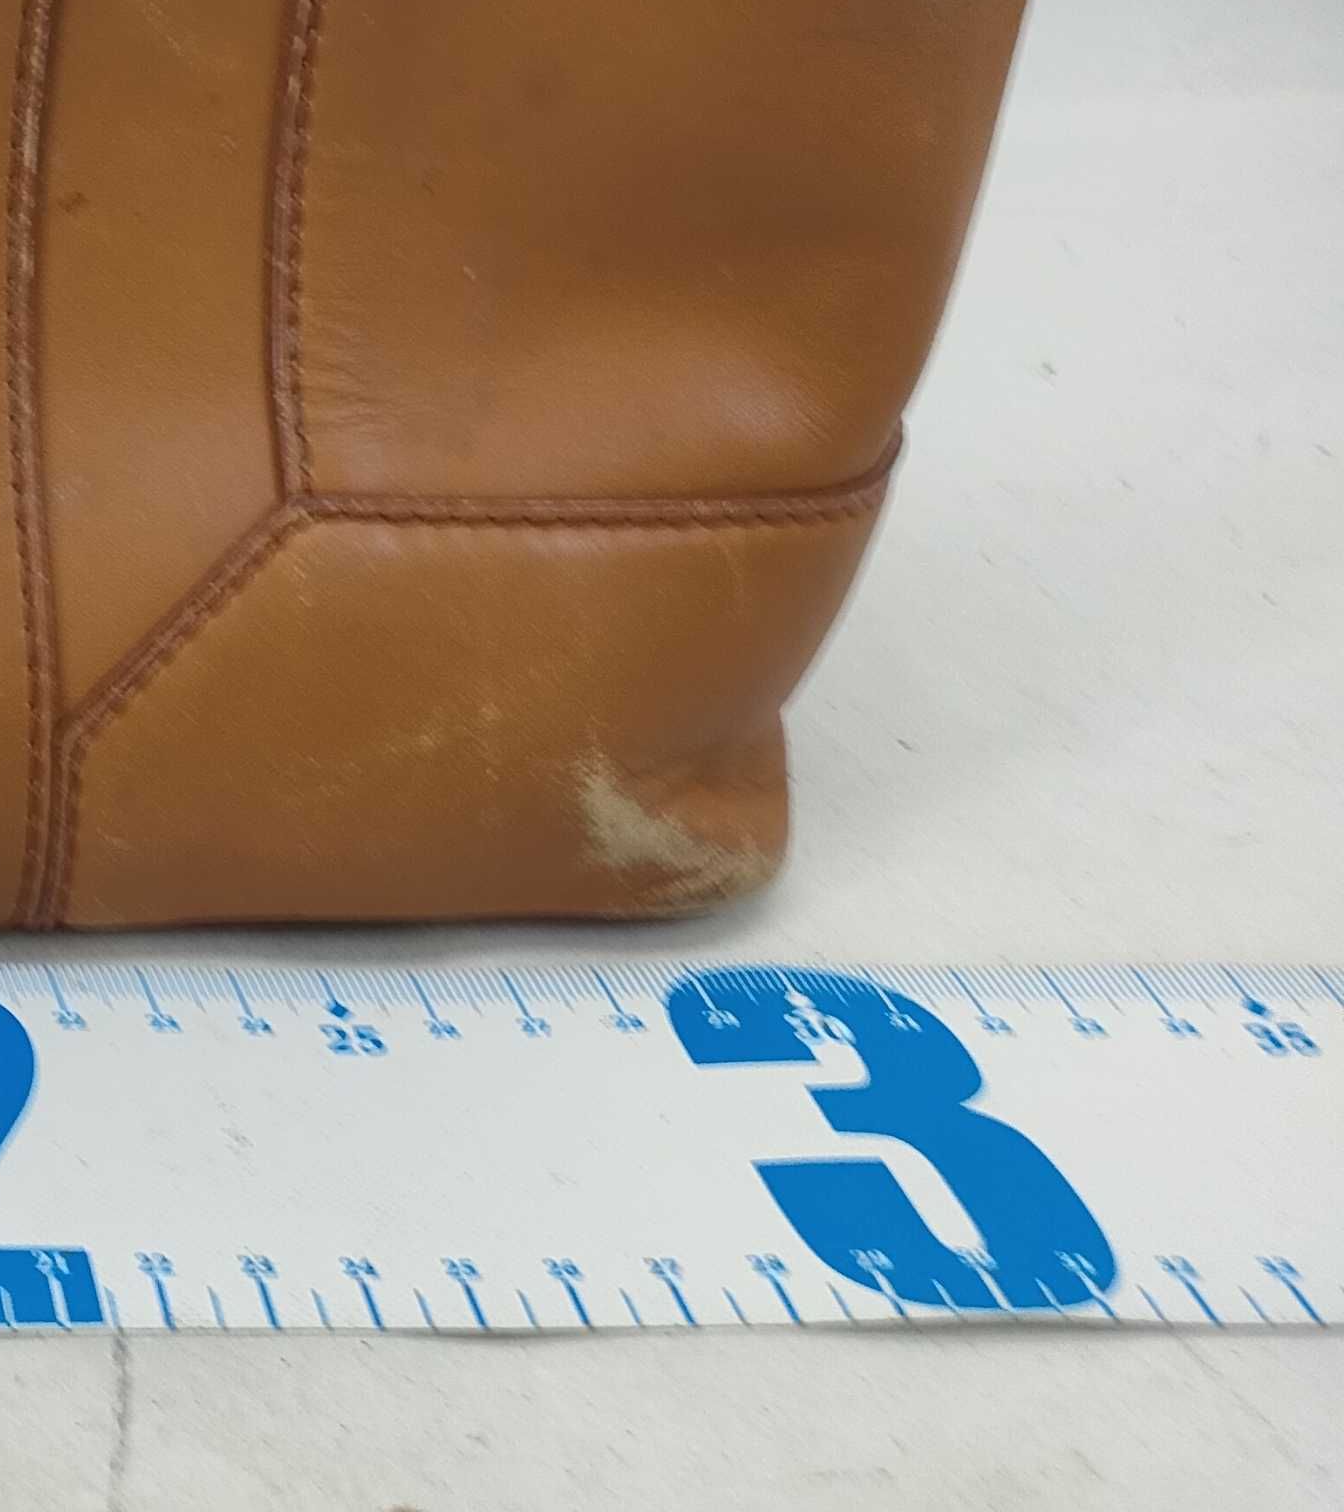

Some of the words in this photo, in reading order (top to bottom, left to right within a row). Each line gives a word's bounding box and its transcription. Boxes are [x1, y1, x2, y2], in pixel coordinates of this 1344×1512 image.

[318, 1024, 388, 1056] 25
[784, 1007, 855, 1044] 30
[1241, 1021, 1322, 1057] 35
[664, 963, 1116, 1310] 3
